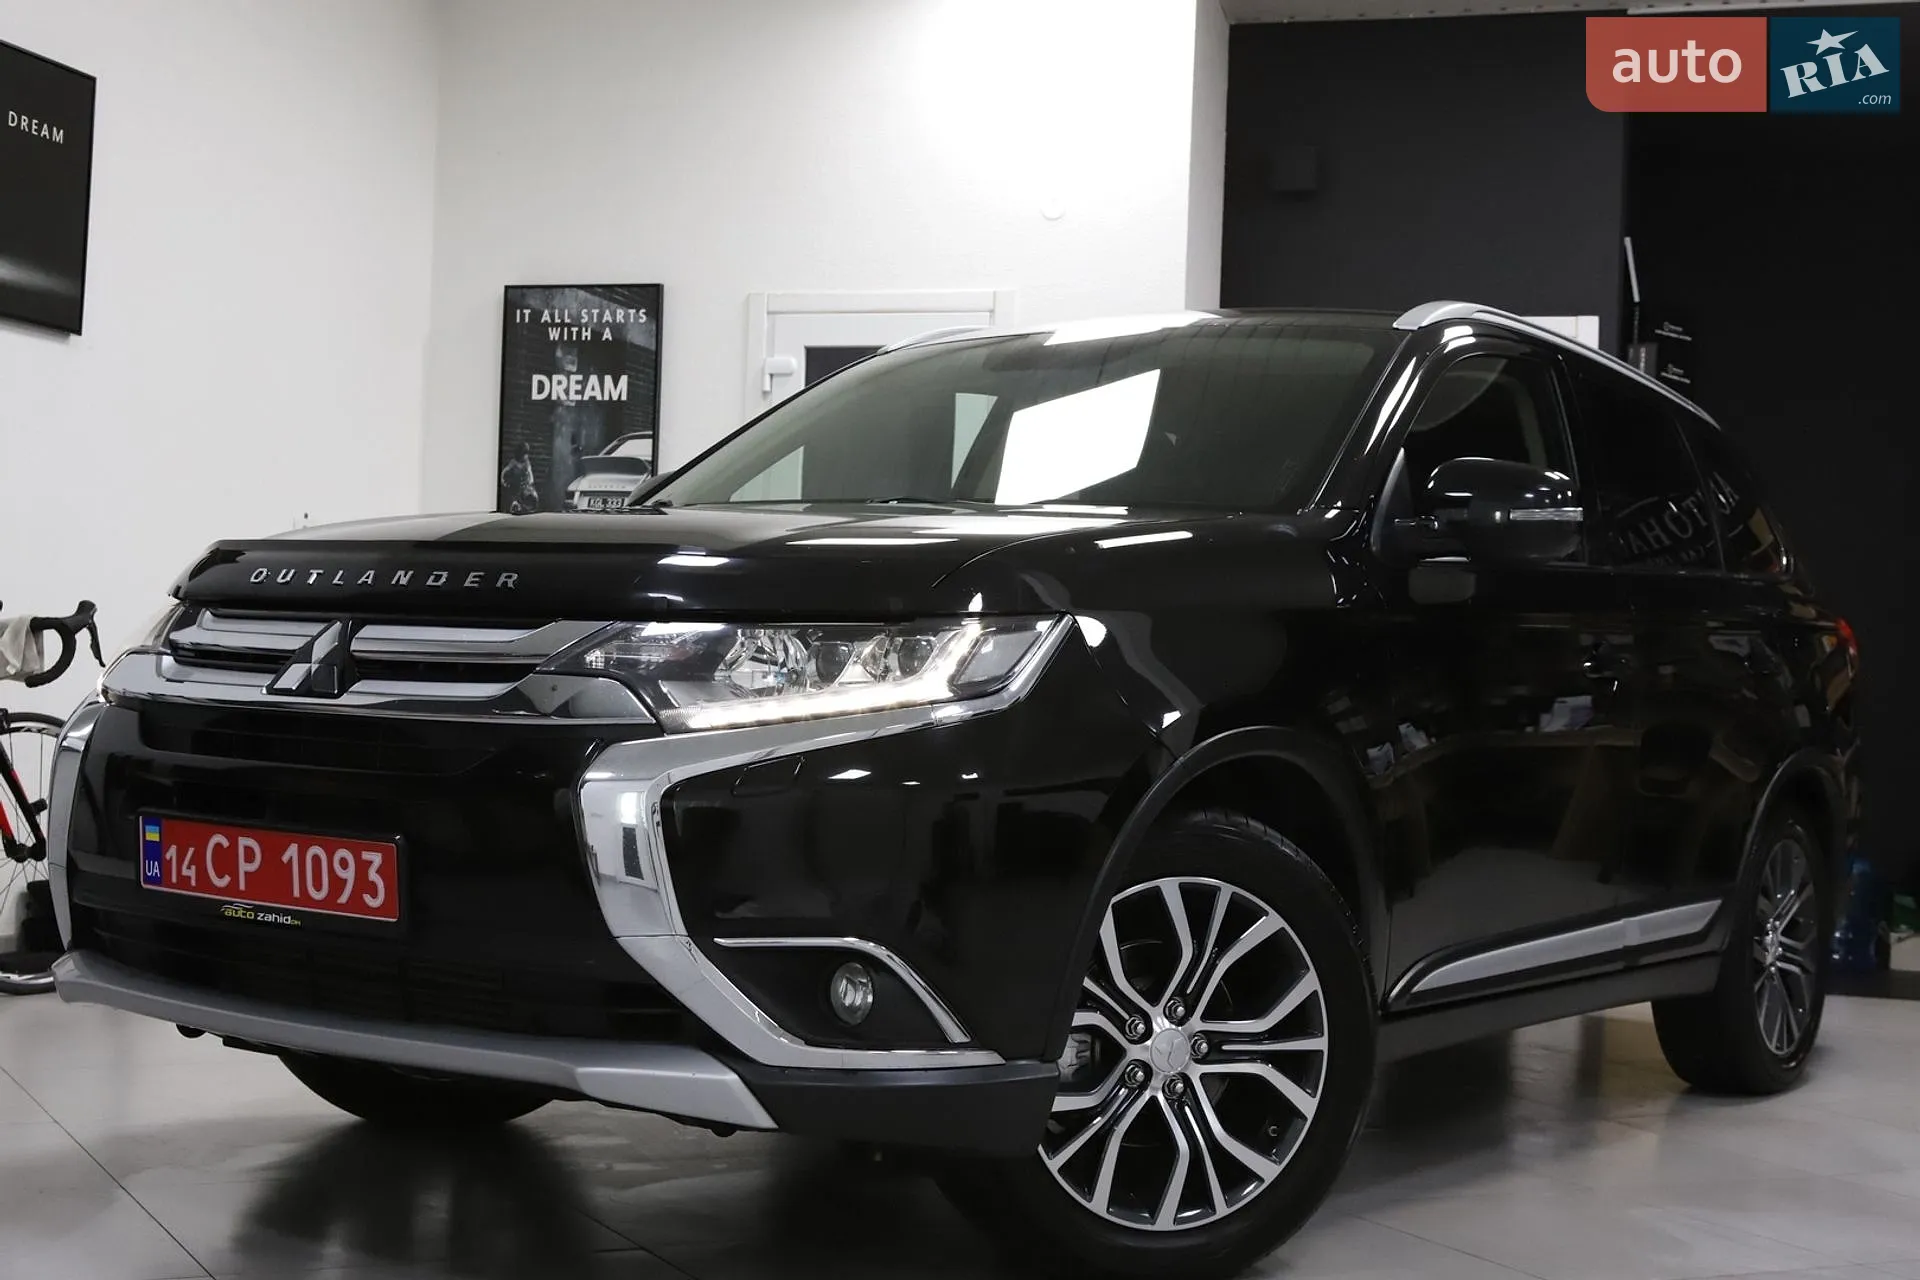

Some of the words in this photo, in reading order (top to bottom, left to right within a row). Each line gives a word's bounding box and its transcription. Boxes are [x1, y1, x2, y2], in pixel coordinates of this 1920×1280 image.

[8, 111, 64, 144] DREAM
[515, 309, 531, 323] IT
[541, 309, 571, 323] ALL
[581, 309, 647, 323] STARTS
[548, 327, 592, 341] WITH
[602, 327, 613, 341] A
[531, 374, 629, 401] DREAM
[250, 567, 519, 589] OUTLANDER
[145, 860, 160, 877] UA
[281, 843, 386, 908] 1093
[223, 907, 255, 919] auto
